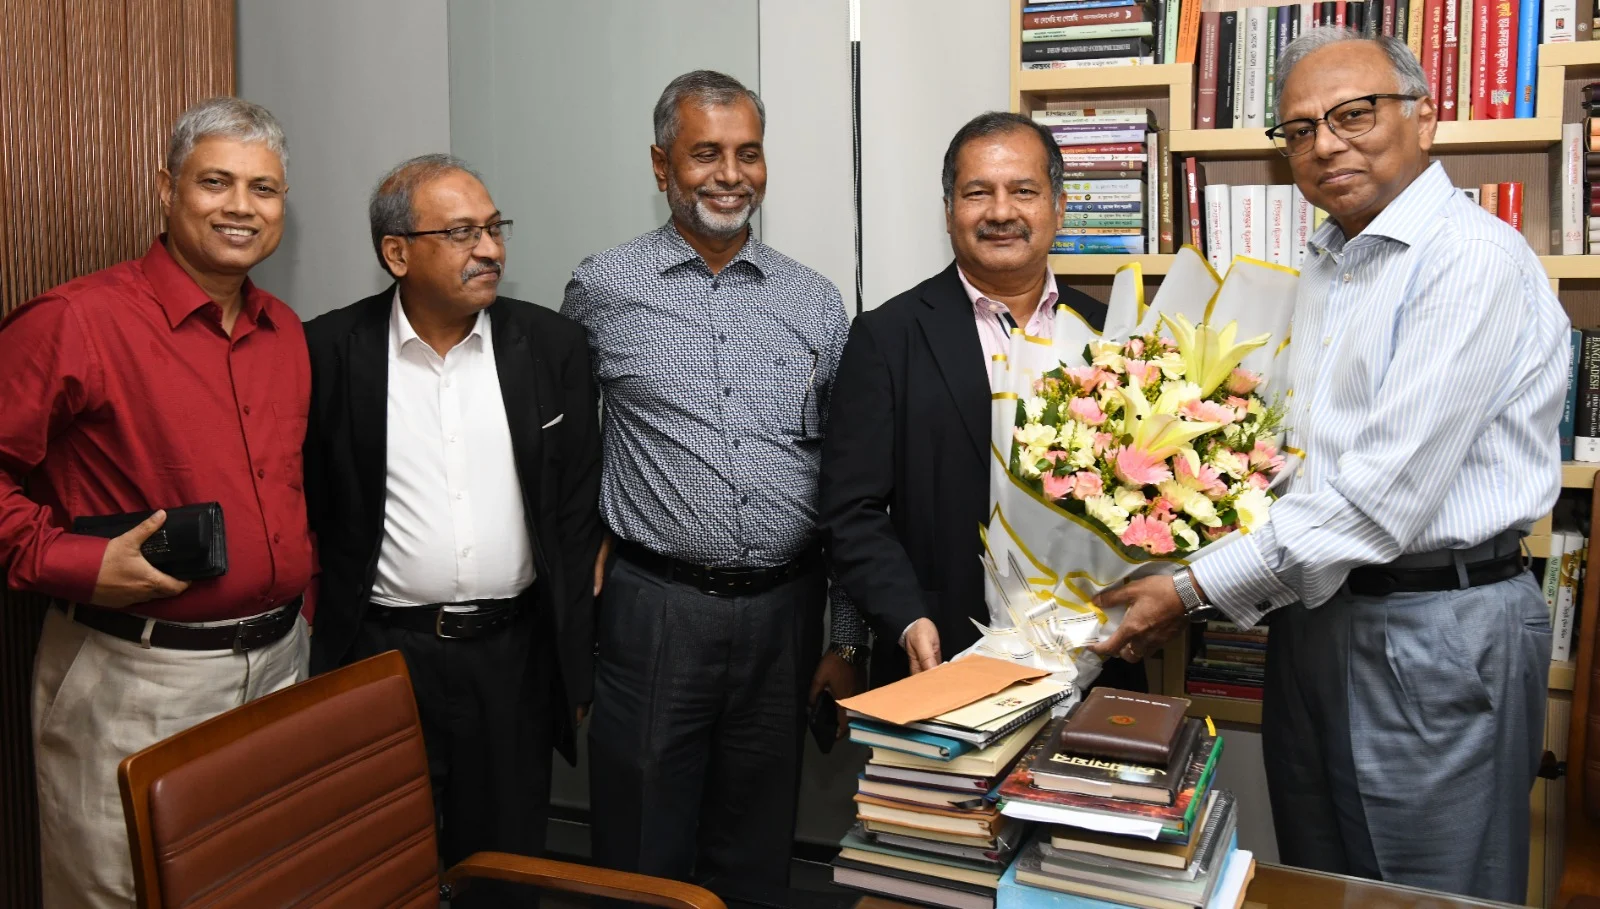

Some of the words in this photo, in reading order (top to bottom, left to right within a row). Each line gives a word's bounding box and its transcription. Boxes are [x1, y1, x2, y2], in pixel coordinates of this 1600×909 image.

[1496, 2, 1512, 17] জুলাই
[1443, 22, 1457, 42] জুলাই
[1496, 18, 1510, 46] ছাত্র-জনতার
[1494, 47, 1509, 67] অভ্যুত্থান
[1496, 69, 1508, 84] ২০২৪
[1491, 192, 1496, 201] MY
[1590, 337, 1600, 389] BANGLADESH
